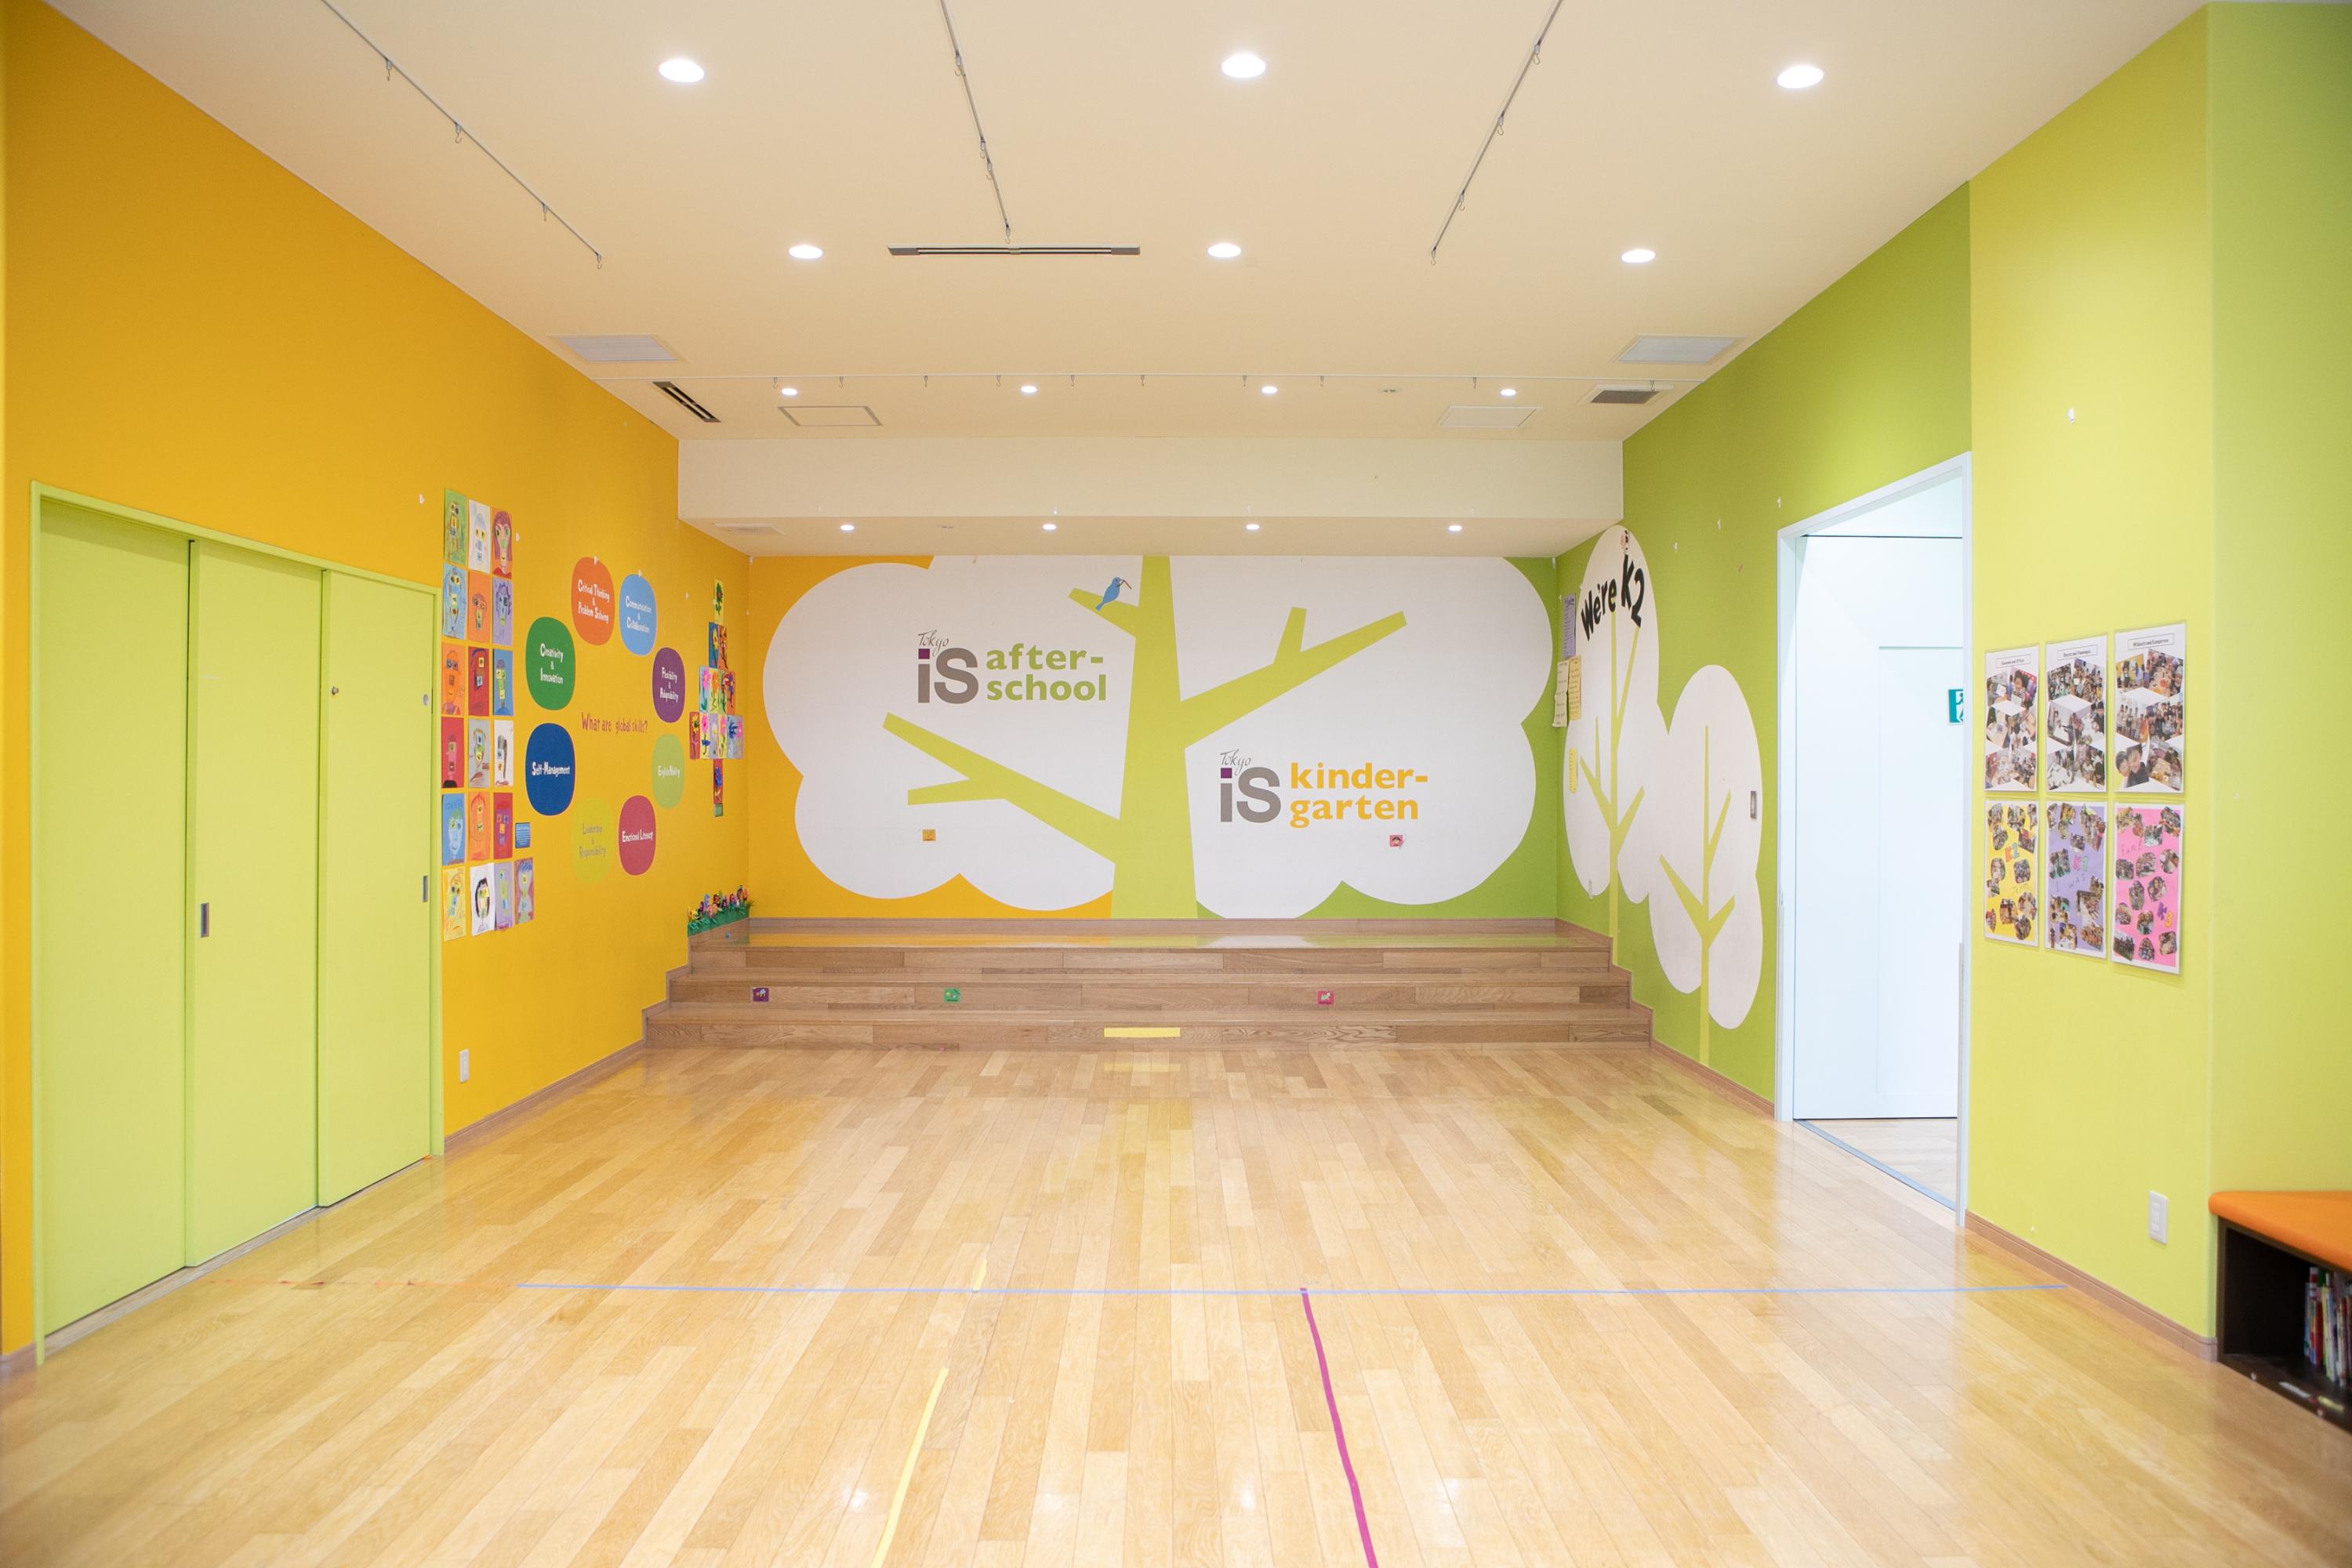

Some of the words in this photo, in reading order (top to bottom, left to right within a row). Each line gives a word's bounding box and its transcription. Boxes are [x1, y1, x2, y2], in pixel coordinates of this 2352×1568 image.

[593, 584, 610, 602] Thinking
[1581, 578, 1617, 641] We're
[1621, 554, 1645, 628] K2
[578, 601, 593, 616] Problem
[594, 607, 609, 624] Solving
[539, 642, 564, 663] Creativity
[918, 630, 949, 657] Tokyo
[986, 643, 1104, 670] after-
[540, 667, 564, 684] Innovation
[986, 674, 1106, 701] school
[581, 712, 600, 731] What
[601, 720, 612, 731] are
[615, 717, 631, 734] global
[632, 720, 648, 734] skills?
[532, 761, 570, 777] Self-Management
[1220, 749, 1251, 775] Tokyo
[1290, 762, 1428, 789] kinder-
[1290, 795, 1418, 829] garten
[622, 830, 640, 843] Emotional
